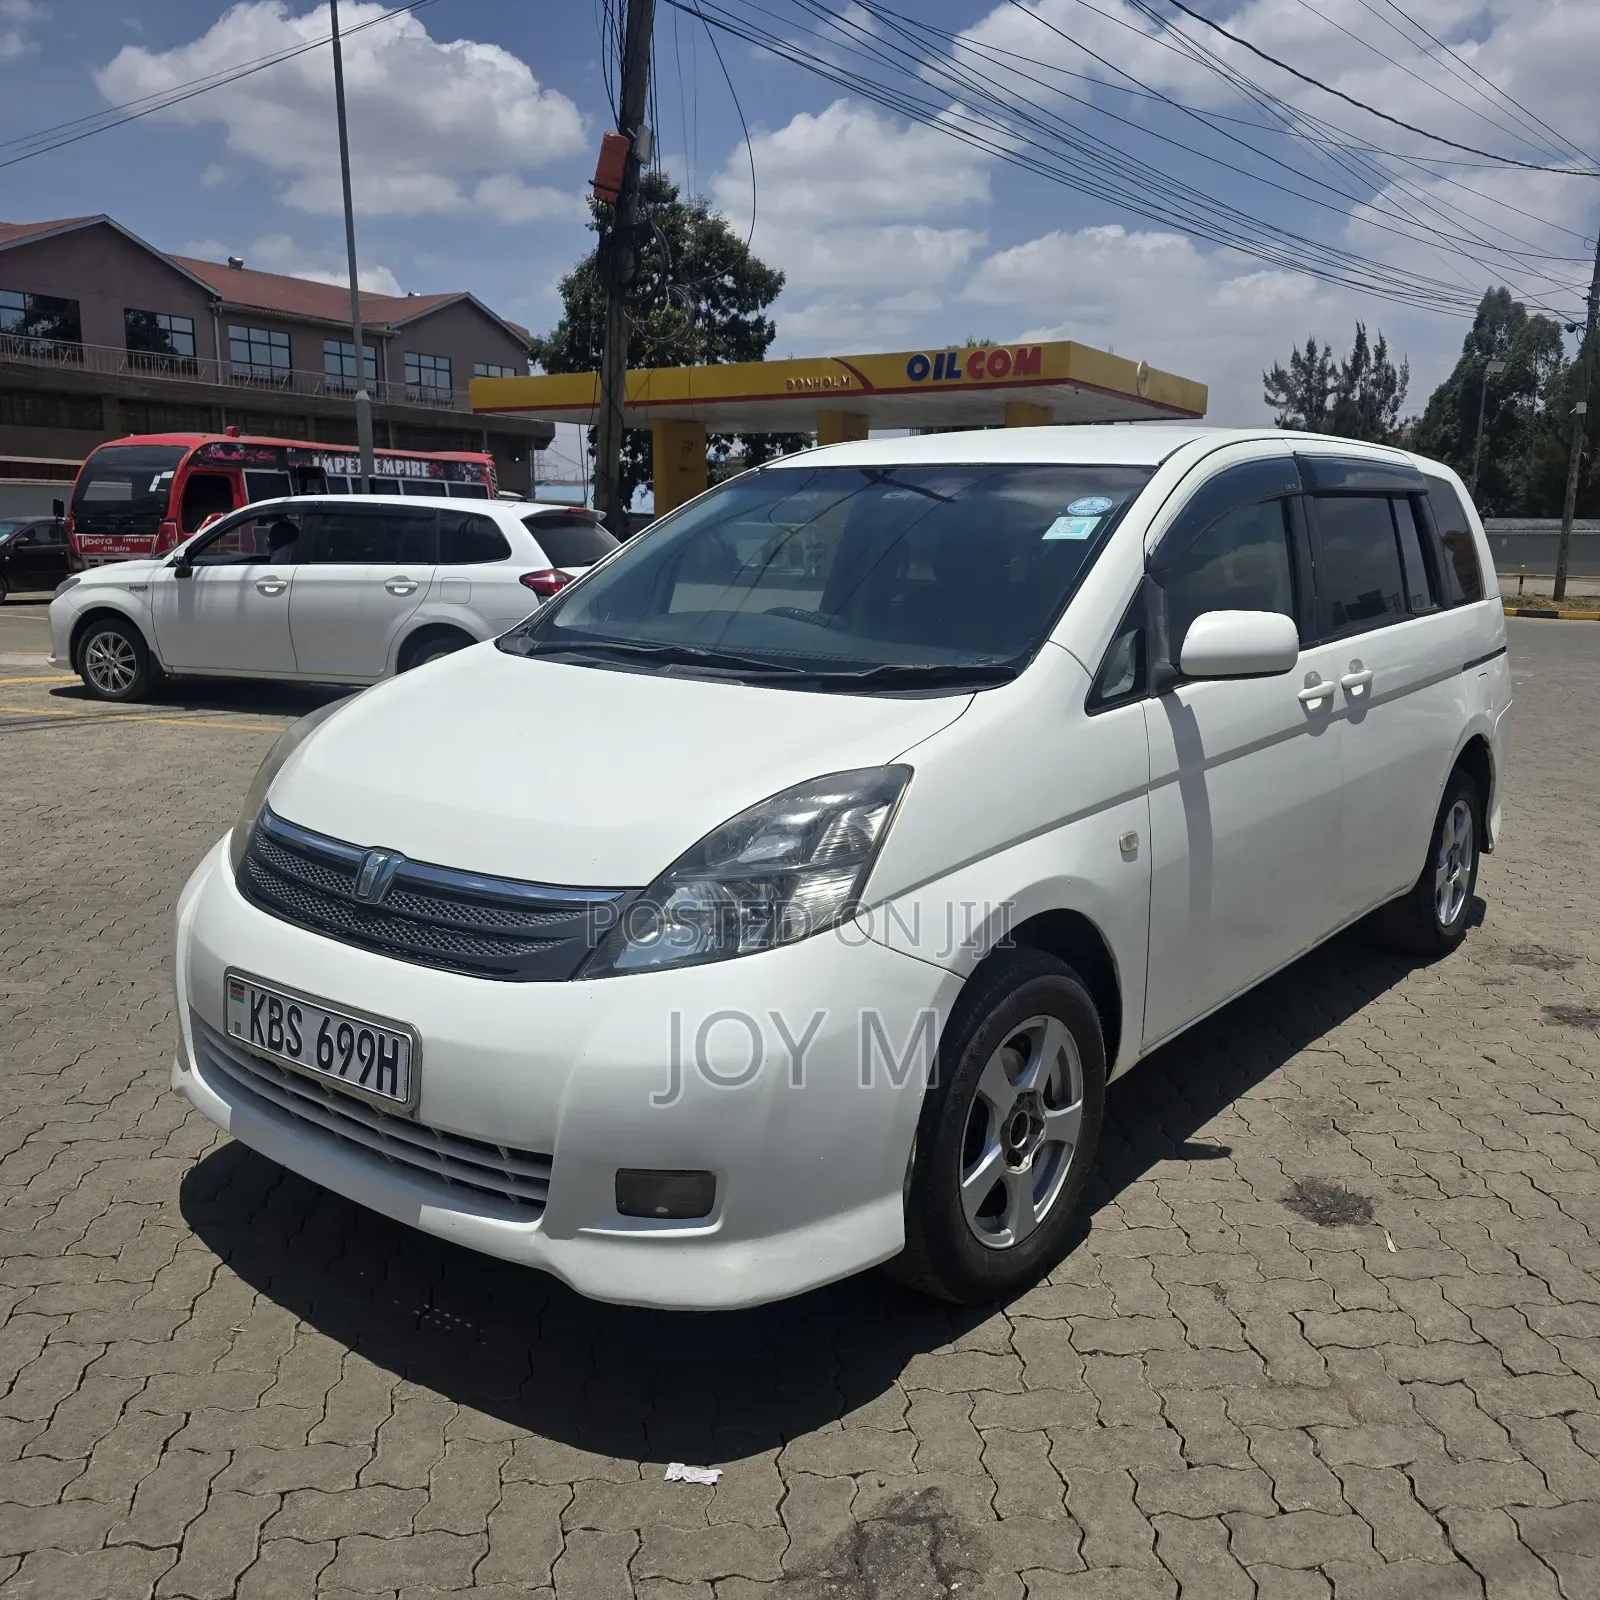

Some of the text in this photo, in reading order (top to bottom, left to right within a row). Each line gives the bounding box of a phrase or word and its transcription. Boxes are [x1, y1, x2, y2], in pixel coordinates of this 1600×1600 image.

[906, 345, 1043, 382] OILCOM
[786, 375, 851, 391] DONHOLM
[374, 457, 431, 477] EMPIRE
[250, 989, 303, 1058] KBS
[316, 1016, 400, 1096] 699H
